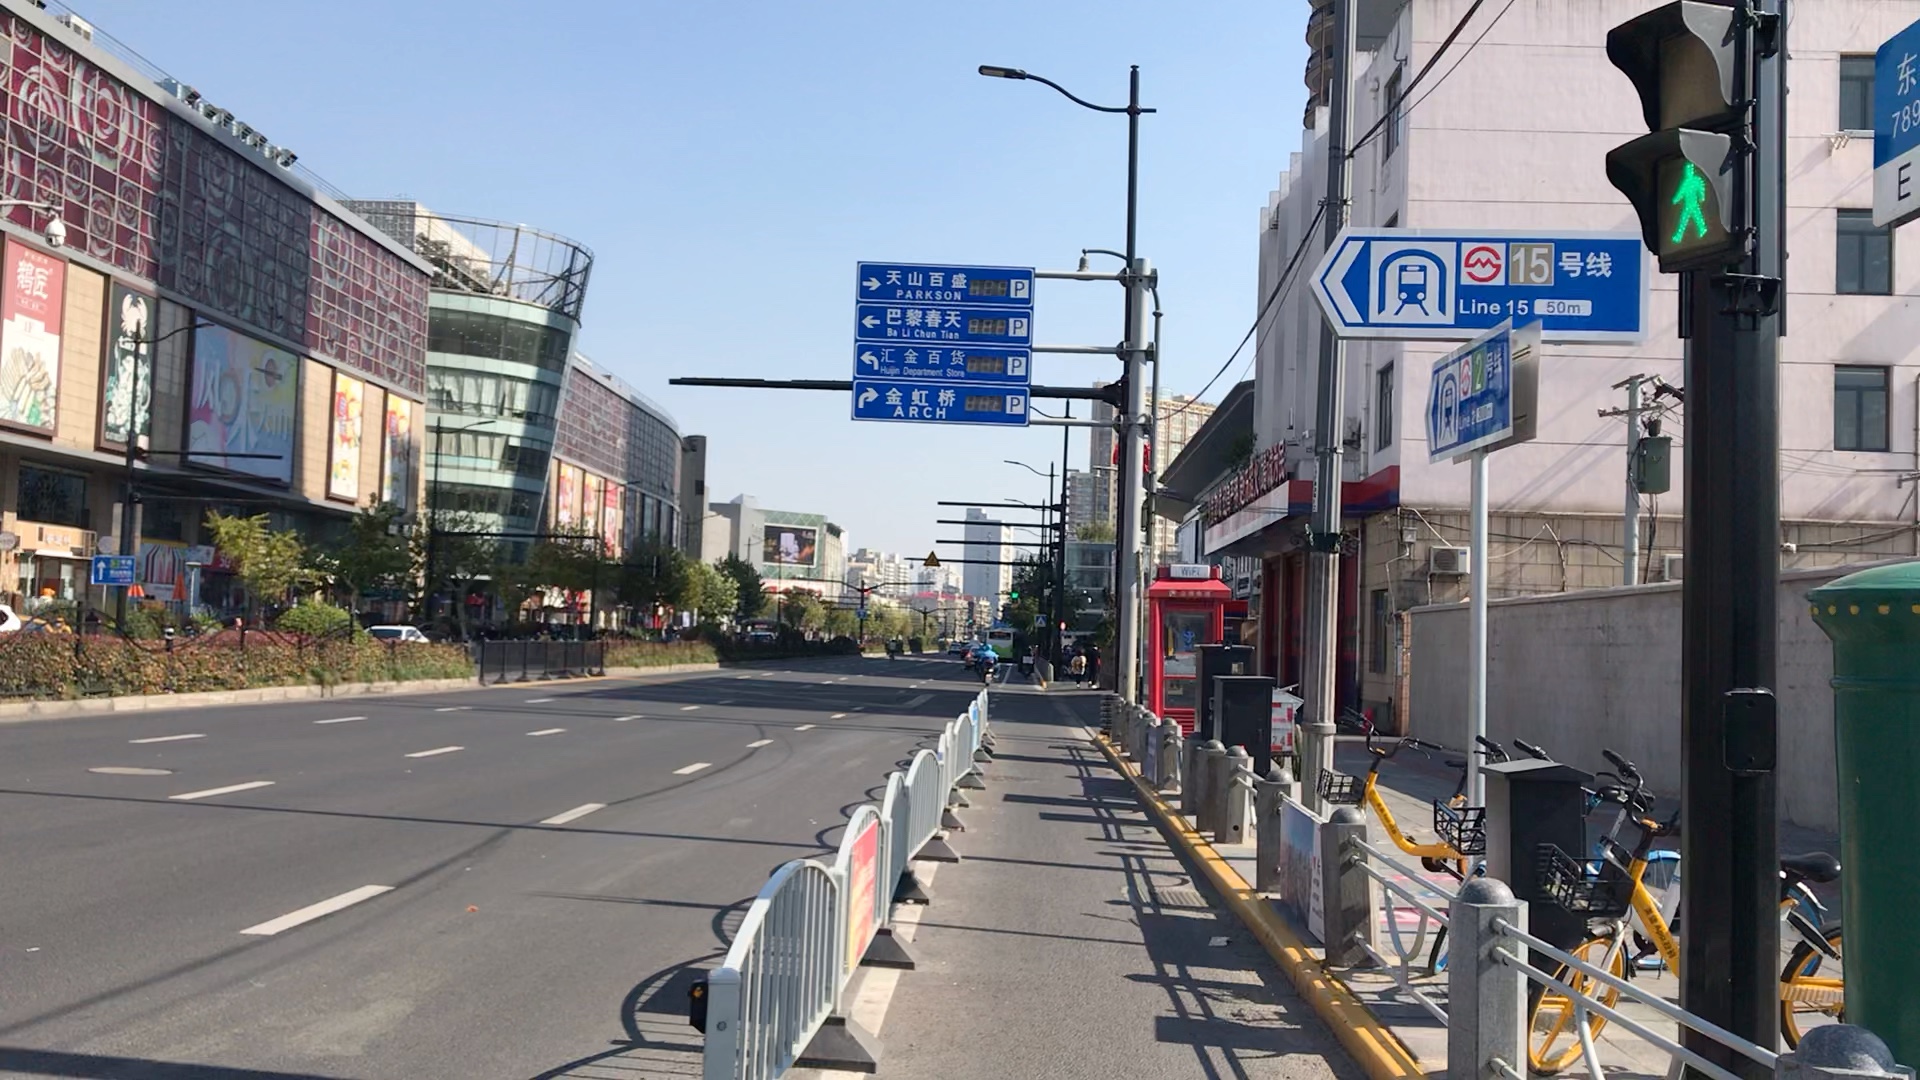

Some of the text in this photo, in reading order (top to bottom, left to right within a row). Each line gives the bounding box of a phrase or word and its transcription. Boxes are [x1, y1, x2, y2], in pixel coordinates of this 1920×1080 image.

[1897, 52, 1920, 96] 东
[1891, 100, 1920, 139] 789
[1897, 162, 1912, 202] E
[886, 270, 968, 289] 天山百盛
[896, 290, 962, 301] PARKSON
[1014, 281, 1025, 297] P
[1459, 299, 1581, 316] Line 15 50m
[886, 309, 962, 328] 巴黎春天
[887, 328, 960, 340] Ba Li Chun Tian
[1013, 320, 1024, 335] P
[880, 348, 966, 366] 汇金百货
[903, 367, 944, 377] Department
[946, 368, 965, 378] Store
[1012, 359, 1022, 374] P
[885, 387, 957, 408] 金虹桥
[1010, 397, 1021, 412] P
[893, 406, 947, 419] ARCH
